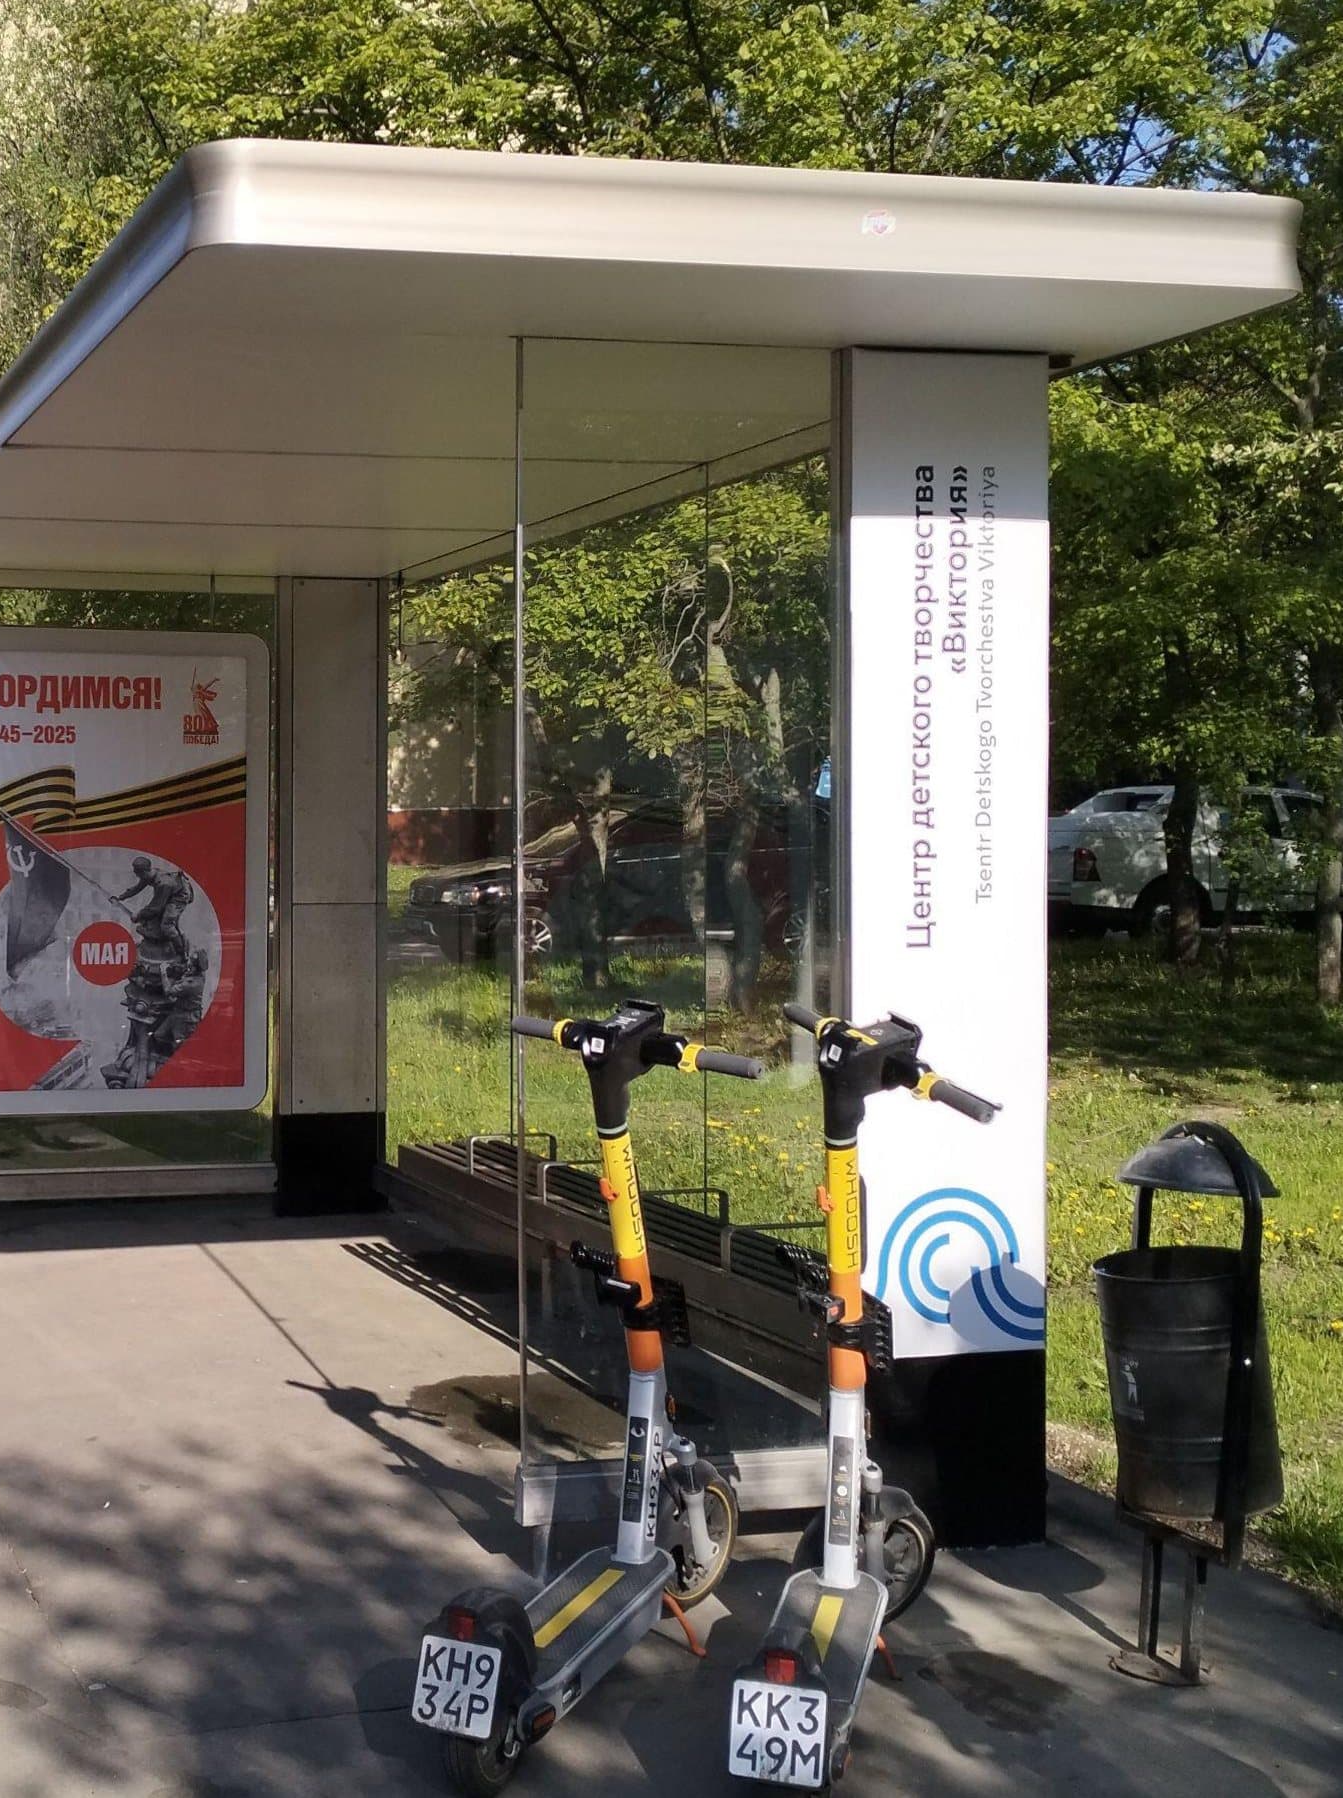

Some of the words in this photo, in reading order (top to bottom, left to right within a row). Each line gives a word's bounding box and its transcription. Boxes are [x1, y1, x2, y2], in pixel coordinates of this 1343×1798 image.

[914, 465, 939, 665] творчества
[942, 465, 973, 674] «Виктория»
[977, 466, 999, 572] Viktoriya
[976, 579, 995, 713] Tvorchestva
[912, 675, 935, 829] детского
[974, 720, 996, 827] Detskogo
[906, 839, 937, 948] Центр
[975, 833, 993, 904] Tsentr
[81, 942, 129, 965] МАЯ
[622, 1143, 645, 1253] WHOOSH
[846, 1158, 860, 1269] WHOOSH
